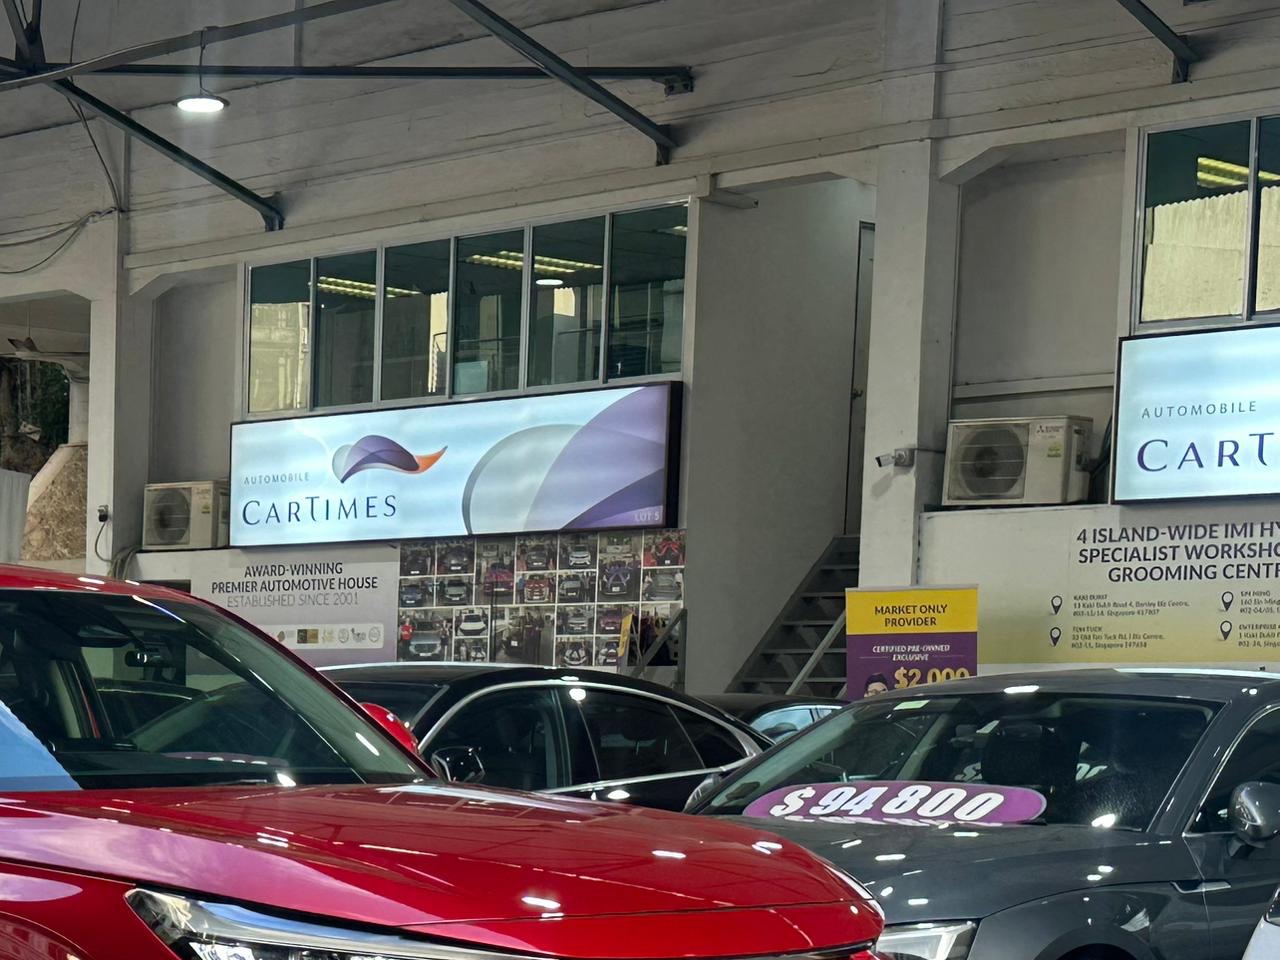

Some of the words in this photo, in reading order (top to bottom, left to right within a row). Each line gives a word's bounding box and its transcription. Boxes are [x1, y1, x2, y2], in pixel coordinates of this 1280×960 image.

[1141, 400, 1257, 419] AUTOMOBILE
[243, 471, 310, 485] AUTOMOBILE
[1076, 528, 1088, 544] 4
[1092, 524, 1219, 543] ISLAND-WIDE
[1224, 522, 1254, 539] IMI
[1078, 545, 1180, 563] SPECIALIST
[244, 562, 343, 578] AWARD-WINNING
[1108, 564, 1217, 582] GROOMING
[211, 581, 257, 594] PREMIER
[260, 578, 336, 593] AUTOMOTIVE
[338, 576, 379, 590] HOUSE
[227, 594, 296, 608] ESTABLISHED
[298, 592, 330, 606] SINCE
[333, 592, 360, 606] 2001
[874, 604, 917, 615] MARKET
[919, 604, 948, 614] ONLY
[885, 617, 937, 627] PROVIDER
